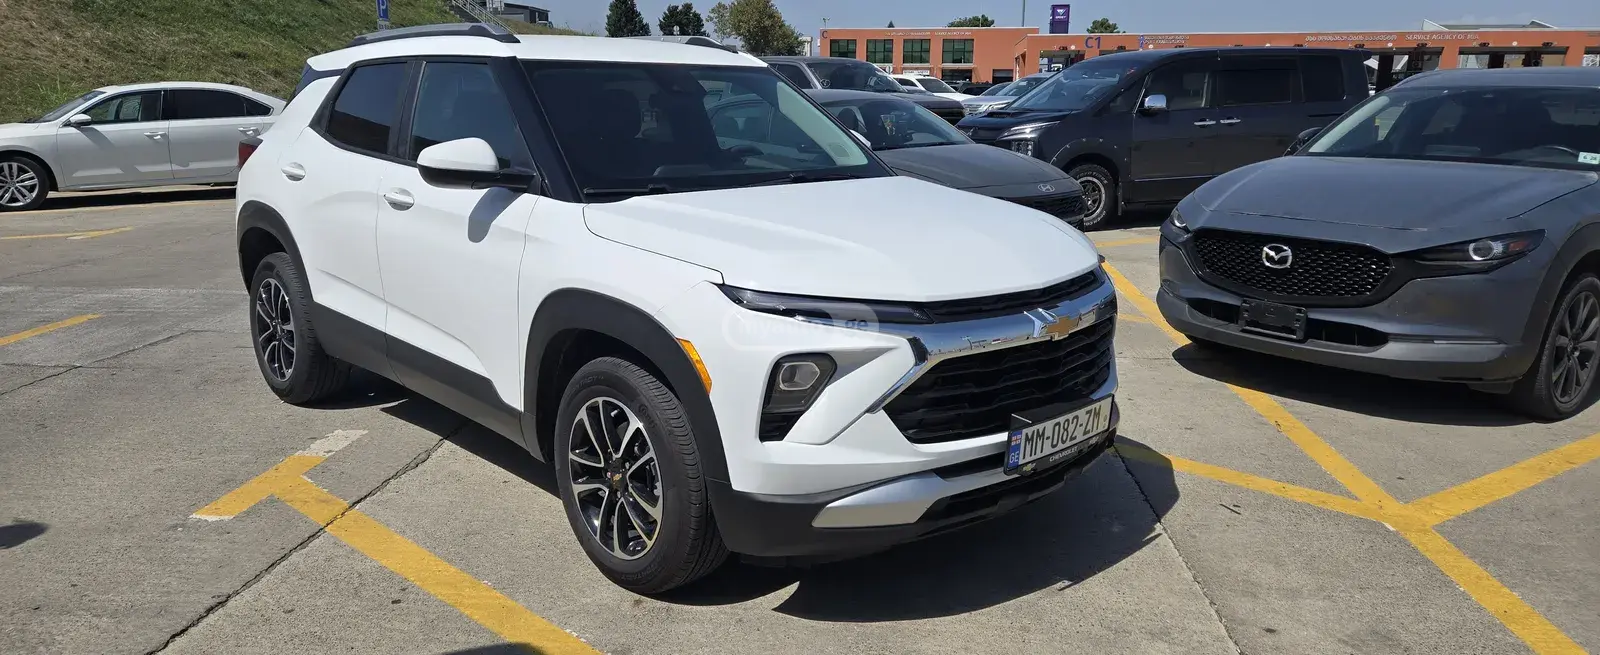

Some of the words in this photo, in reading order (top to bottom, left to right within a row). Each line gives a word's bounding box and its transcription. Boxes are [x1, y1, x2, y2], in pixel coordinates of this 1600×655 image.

[379, 0, 387, 16] P
[822, 30, 828, 39] C
[1085, 36, 1101, 49] C1
[1023, 405, 1102, 460] MM-082-ZM
[1010, 451, 1019, 463] GE
[1050, 446, 1078, 463] CHEVROLET
